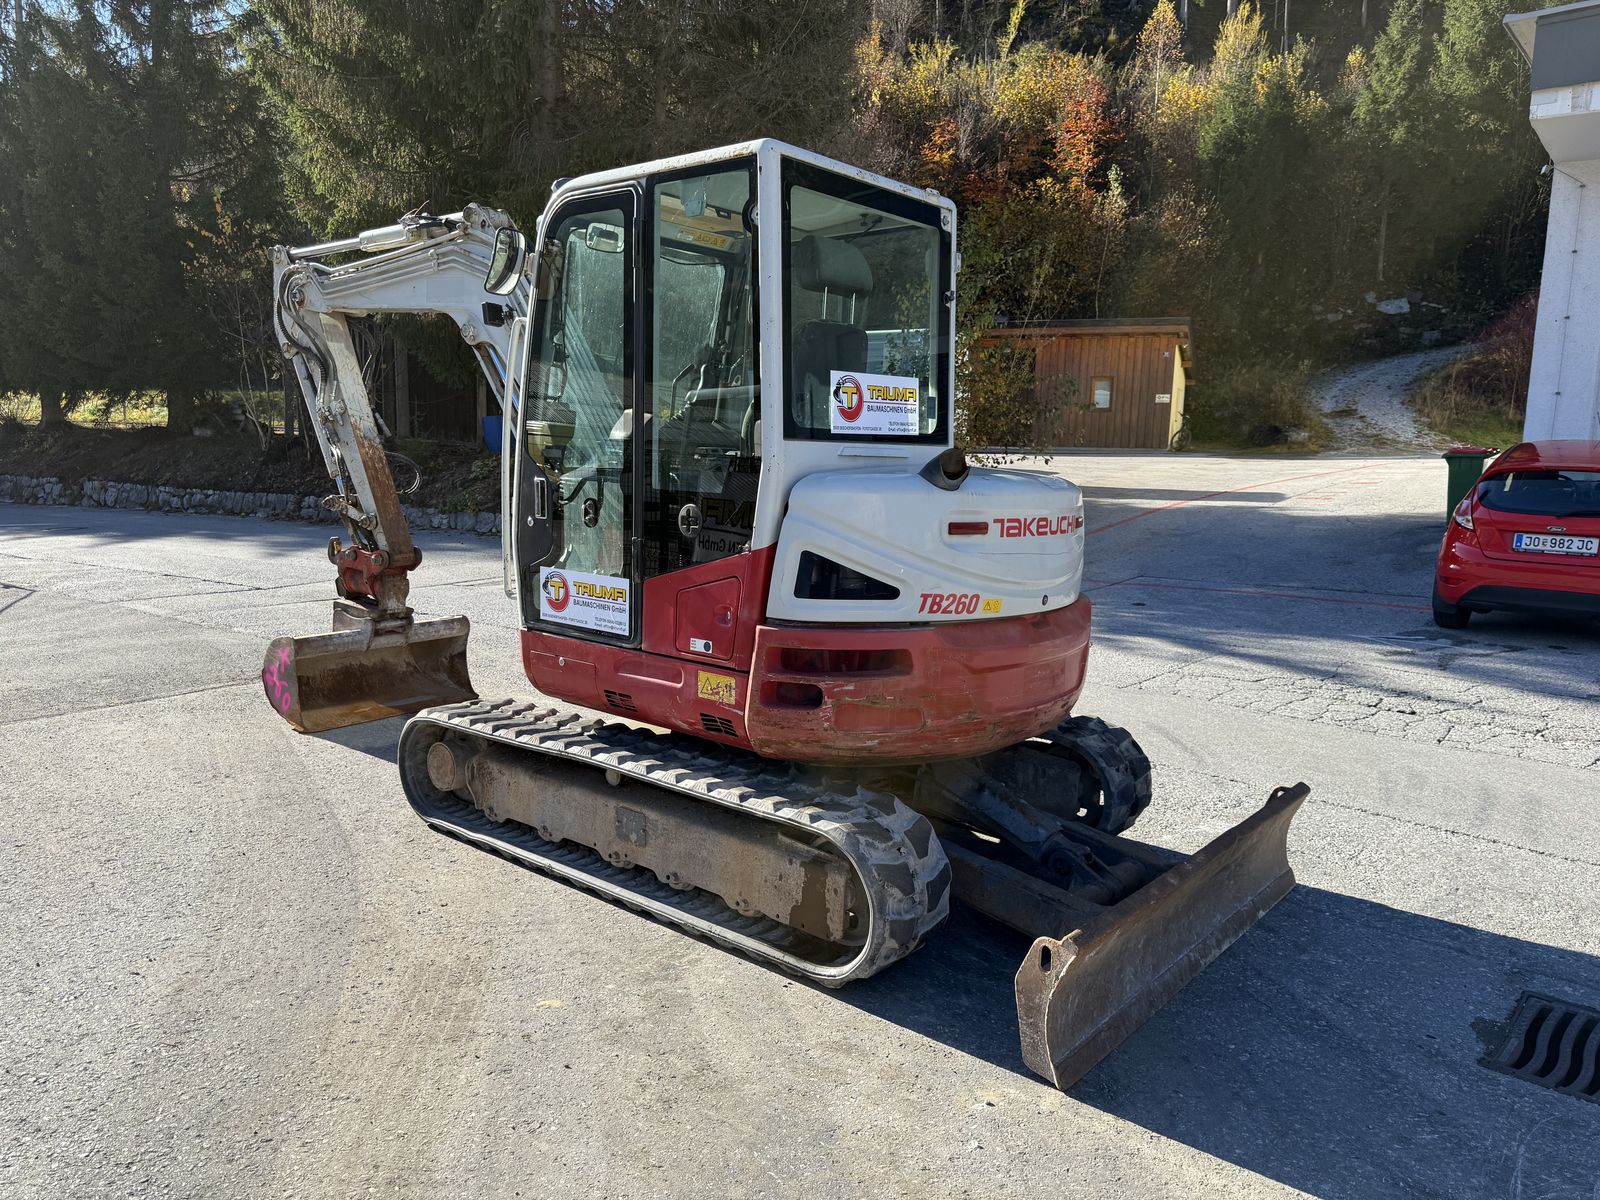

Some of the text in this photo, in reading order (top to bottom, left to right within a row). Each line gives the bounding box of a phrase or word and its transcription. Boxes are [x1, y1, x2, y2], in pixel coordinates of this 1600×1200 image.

[867, 385, 917, 403] TRIUMFI
[867, 405, 917, 414] BAUMASCHINEN GmbH
[1550, 538, 1574, 550] 982
[1576, 539, 1594, 551] JC
[573, 581, 627, 603] TRIUMFI
[573, 598, 627, 614] BAUMASCHINEN GmbH
[918, 593, 981, 614] TB260
